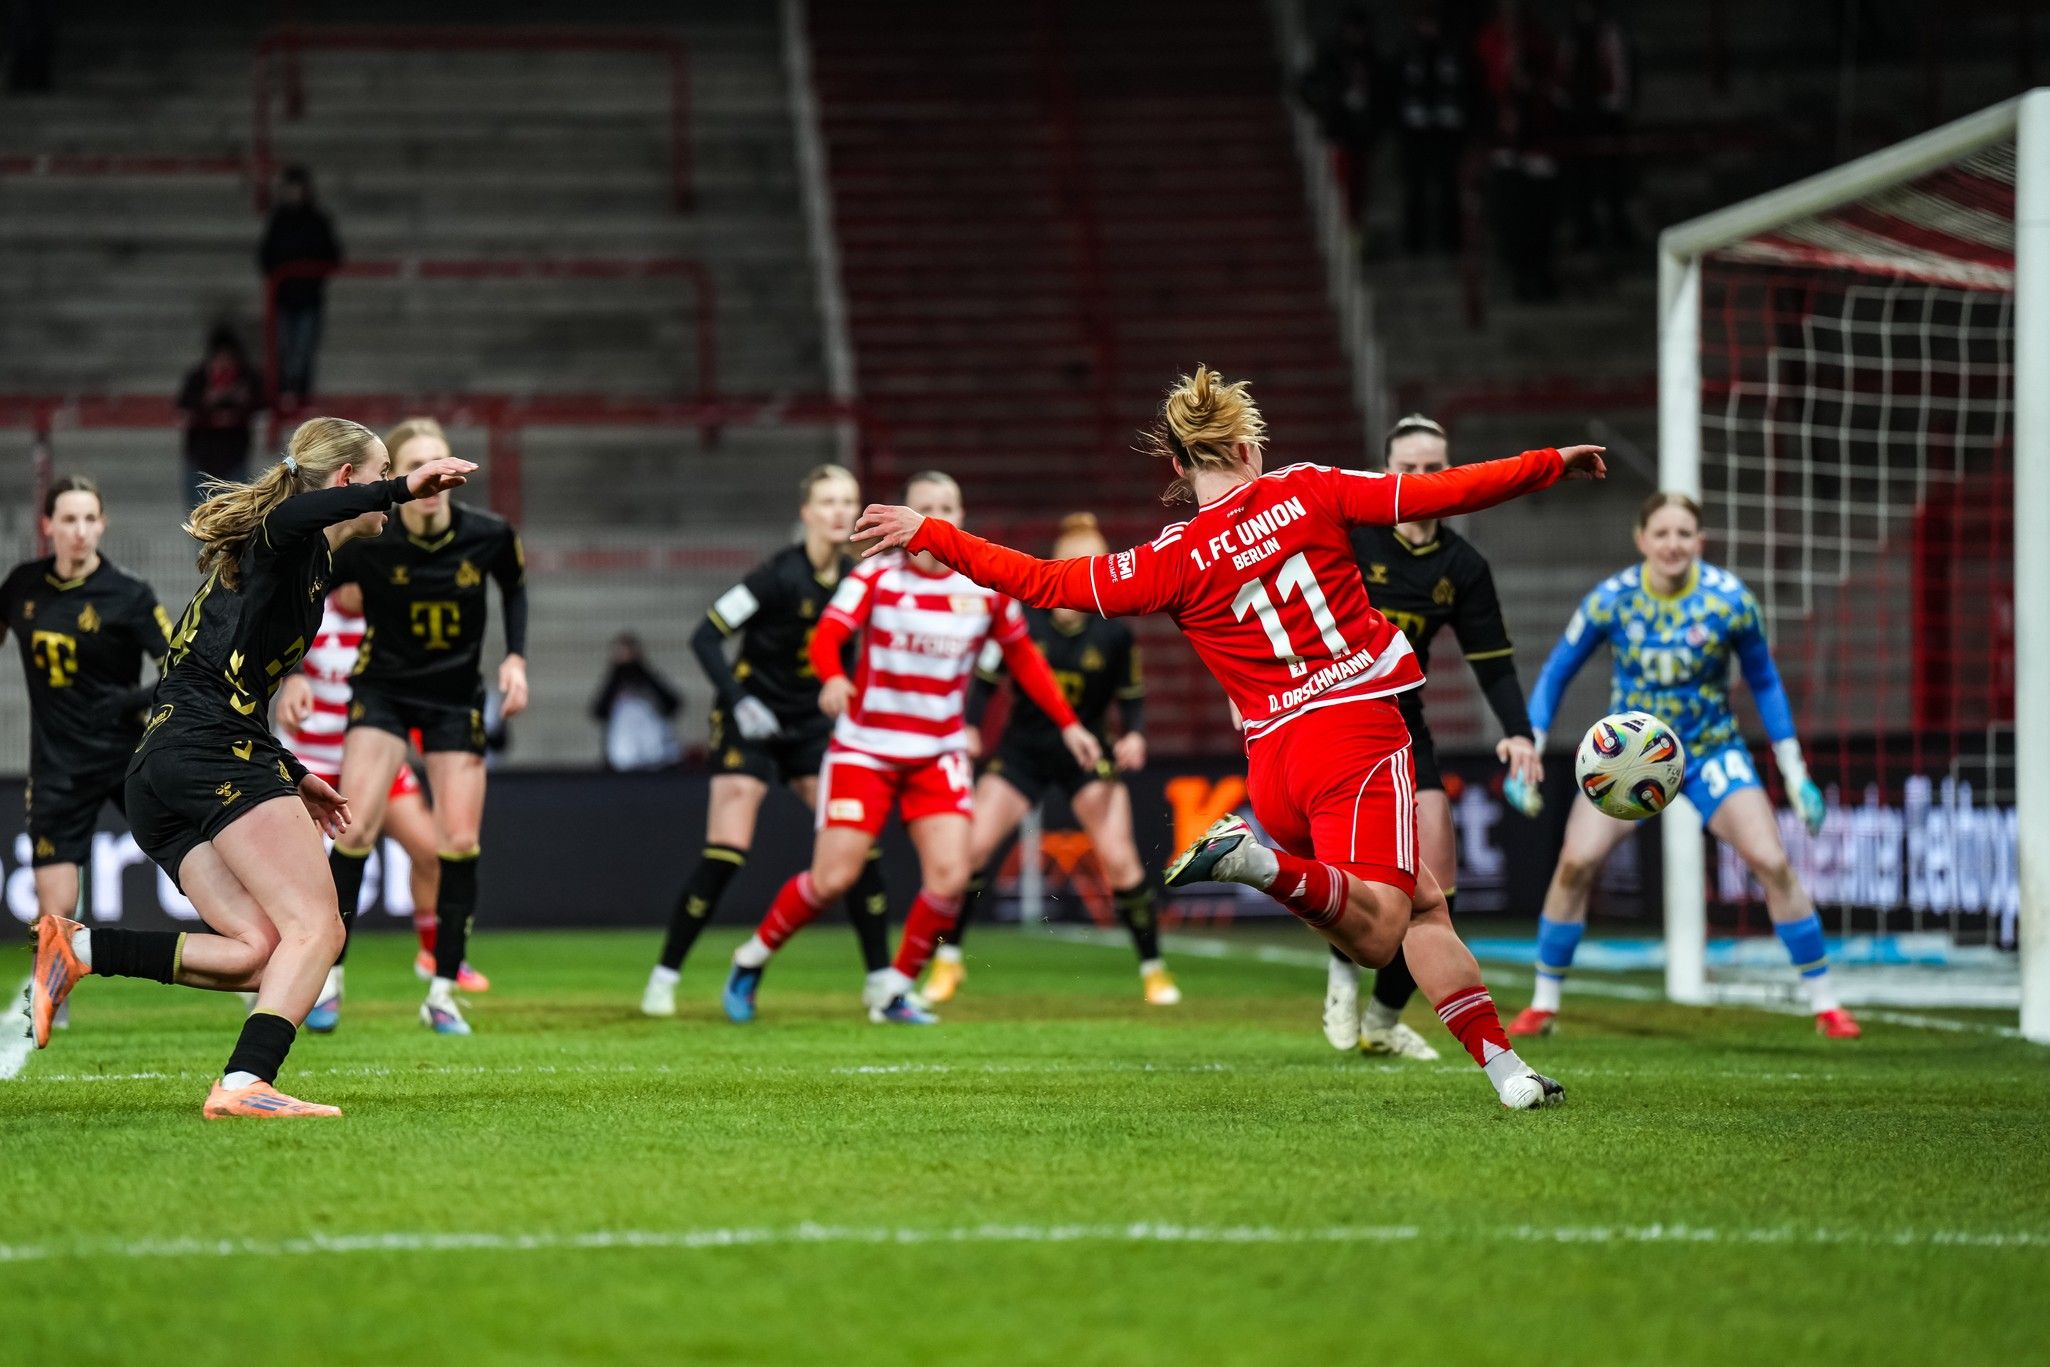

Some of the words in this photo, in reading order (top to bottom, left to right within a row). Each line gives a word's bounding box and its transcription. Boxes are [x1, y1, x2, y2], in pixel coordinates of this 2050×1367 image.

[1209, 530, 1240, 562] FC
[1240, 496, 1307, 546] UNION
[1231, 537, 1281, 571] BERLIN
[1231, 552, 1351, 678] 11
[1282, 648, 1375, 709] ORSCHMANN
[1701, 750, 1753, 799] 34
